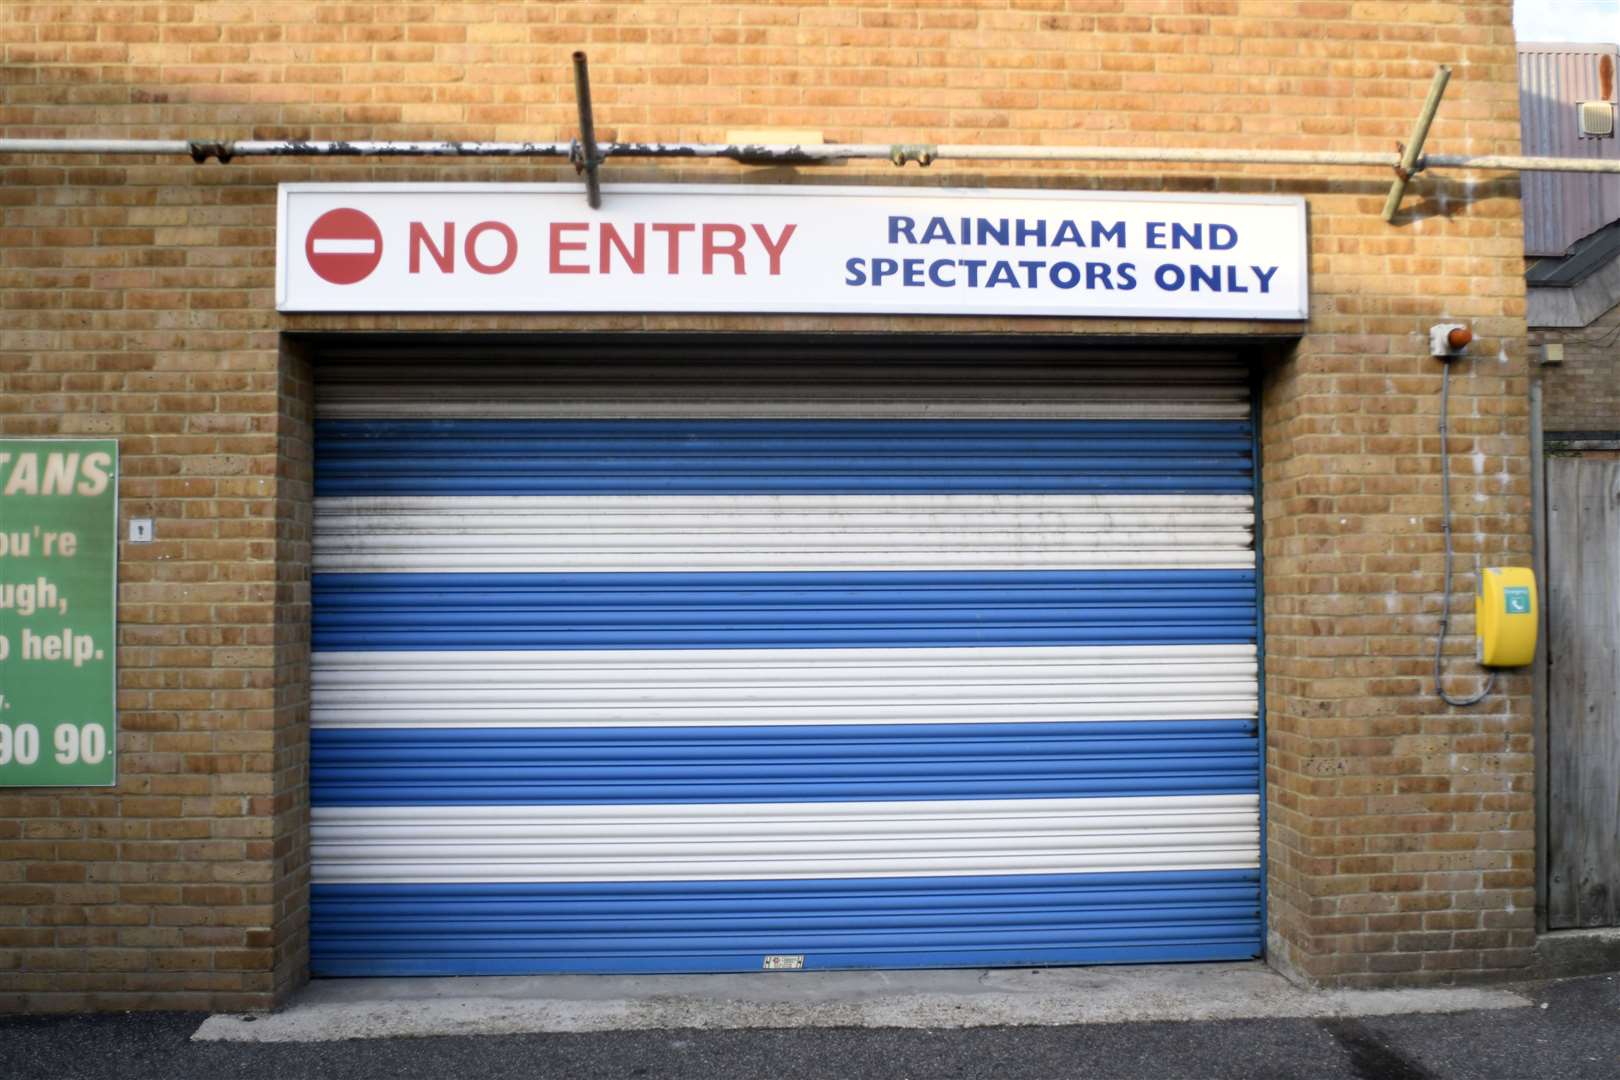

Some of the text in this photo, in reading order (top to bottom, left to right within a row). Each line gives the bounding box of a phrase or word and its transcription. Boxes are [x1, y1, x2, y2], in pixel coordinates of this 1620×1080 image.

[409, 220, 798, 276] NO ENTRY
[887, 215, 1239, 251] RAINHAM END
[845, 257, 1279, 294] SPECTATORS ONLY
[22, 628, 104, 667] help.
[54, 723, 106, 765] 90
